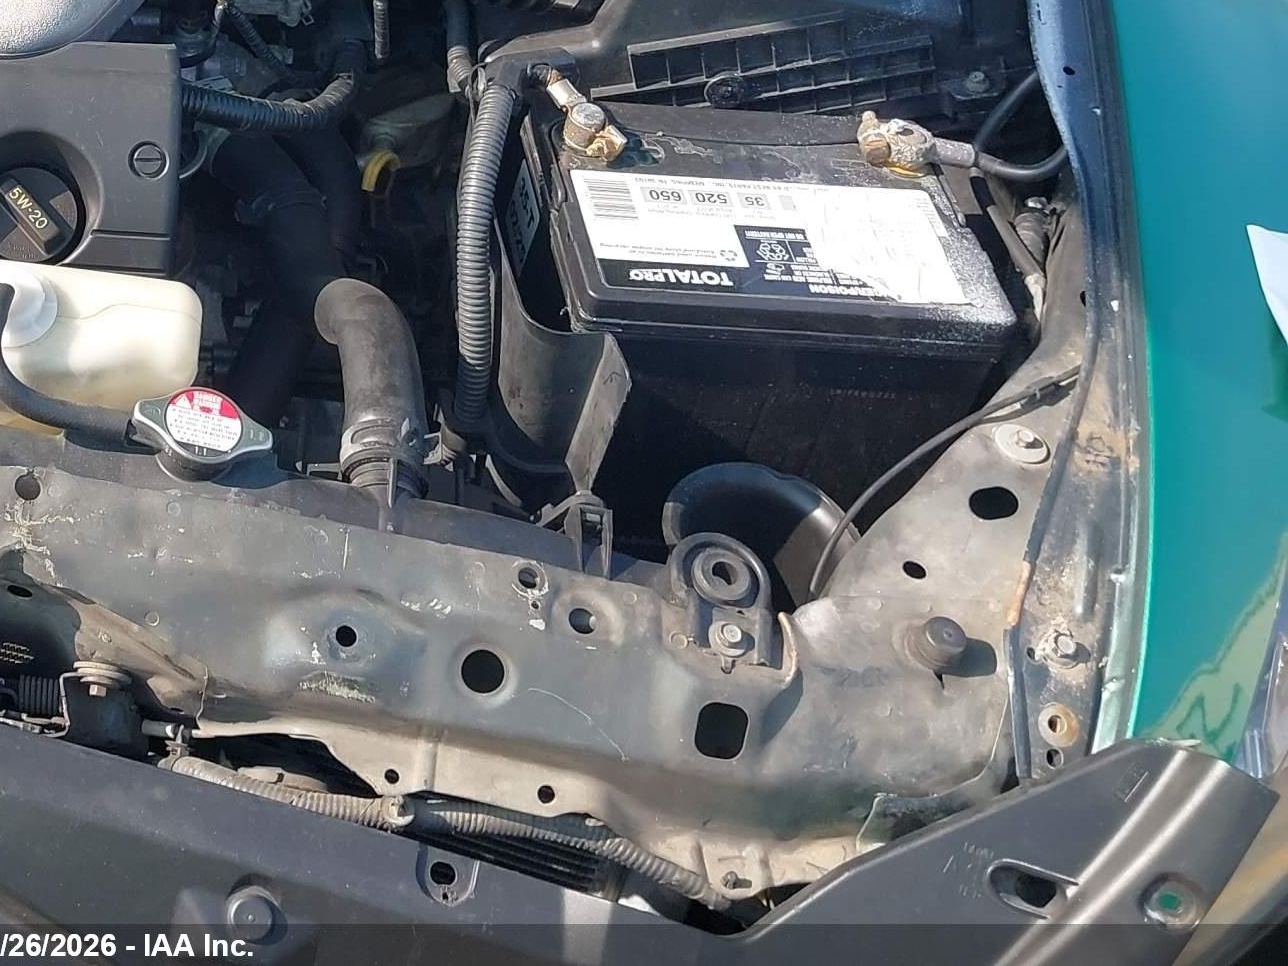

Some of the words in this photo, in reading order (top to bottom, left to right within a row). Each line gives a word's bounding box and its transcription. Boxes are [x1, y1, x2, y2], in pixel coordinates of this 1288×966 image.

[648, 189, 682, 203] 650
[695, 192, 728, 205] 520
[744, 195, 765, 207] 35
[8, 187, 48, 230] 5W-20
[628, 268, 734, 287] TOTALPRO
